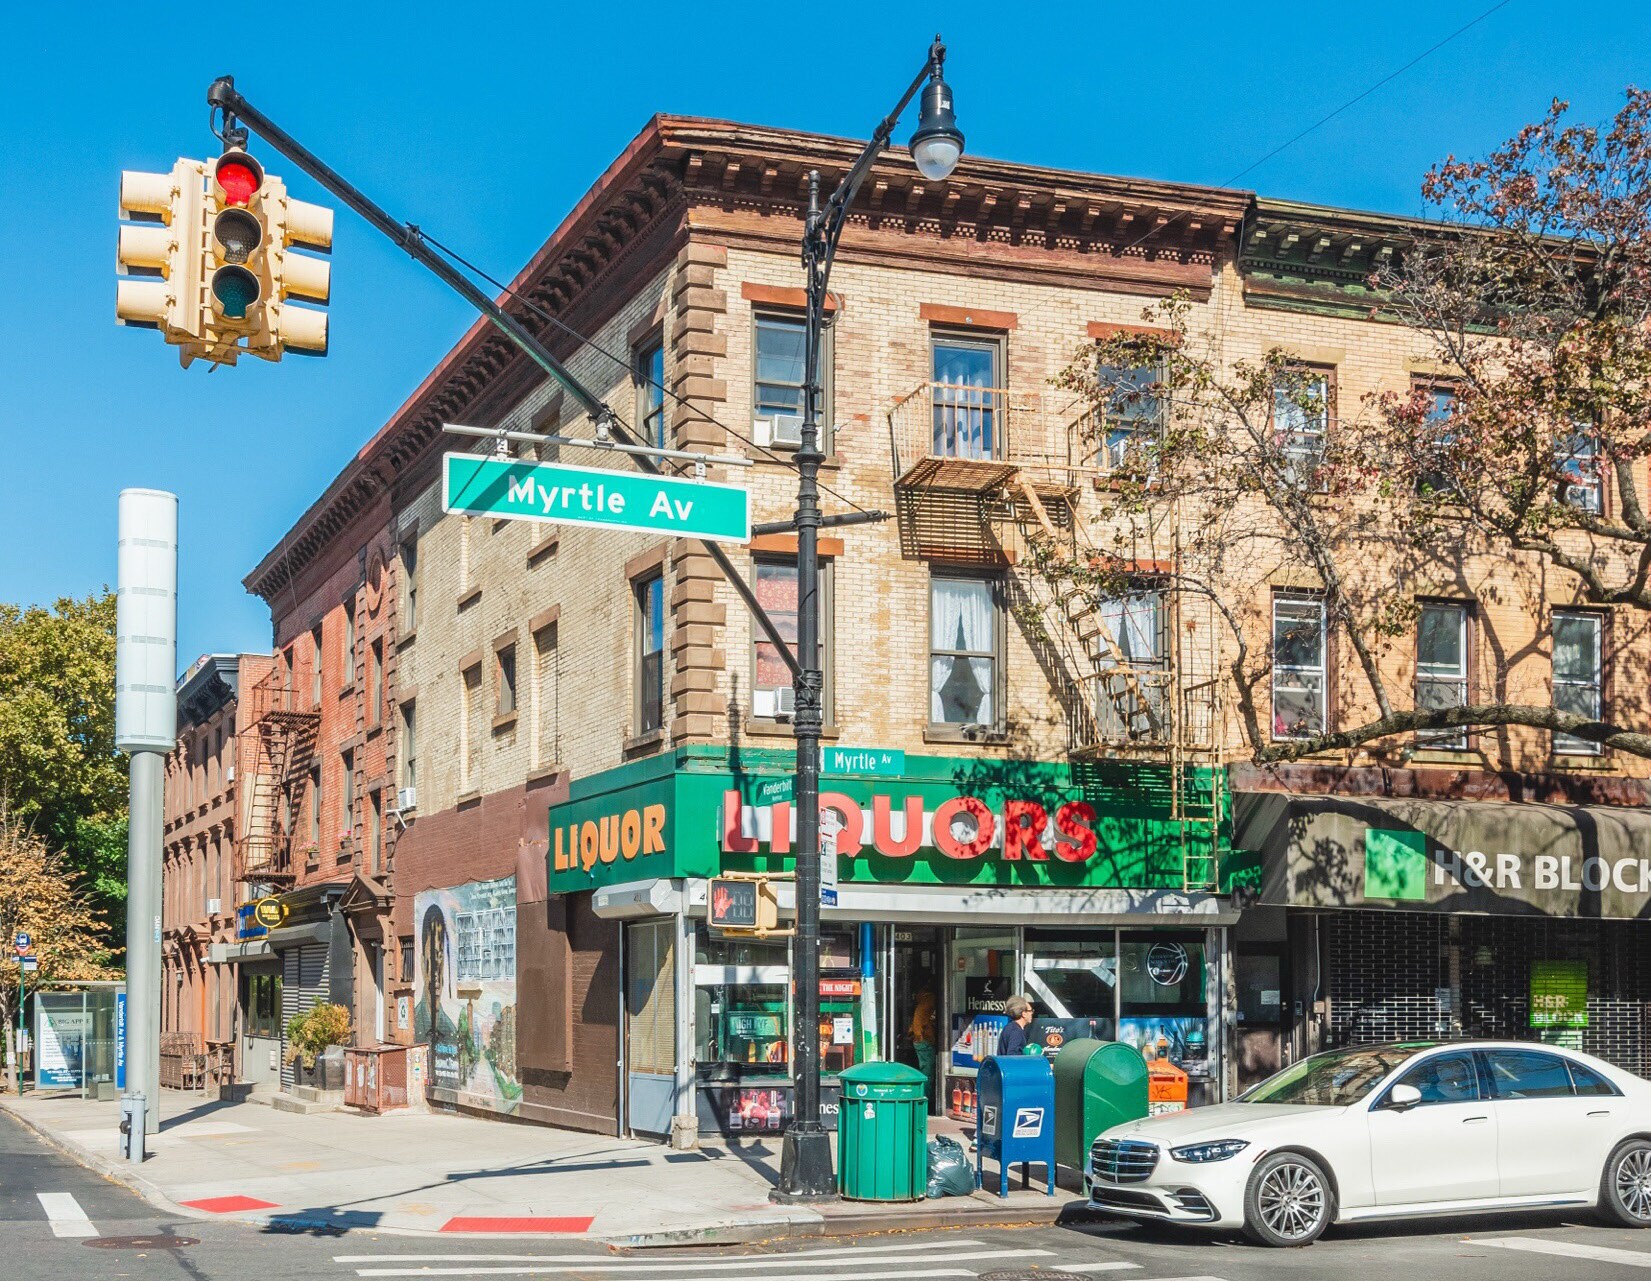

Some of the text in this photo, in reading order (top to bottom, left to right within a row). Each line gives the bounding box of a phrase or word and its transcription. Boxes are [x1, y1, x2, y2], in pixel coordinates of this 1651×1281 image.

[508, 474, 694, 522] Myrtle Av
[834, 751, 892, 773] Myrtle Av
[763, 778, 793, 796] Vanderbilt
[555, 803, 666, 873] LIQUOR
[722, 788, 1098, 863] LIQUORS
[1434, 850, 1522, 888] H&R
[822, 983, 854, 993] THE NIGHT
[968, 996, 1007, 1014] Hennessy
